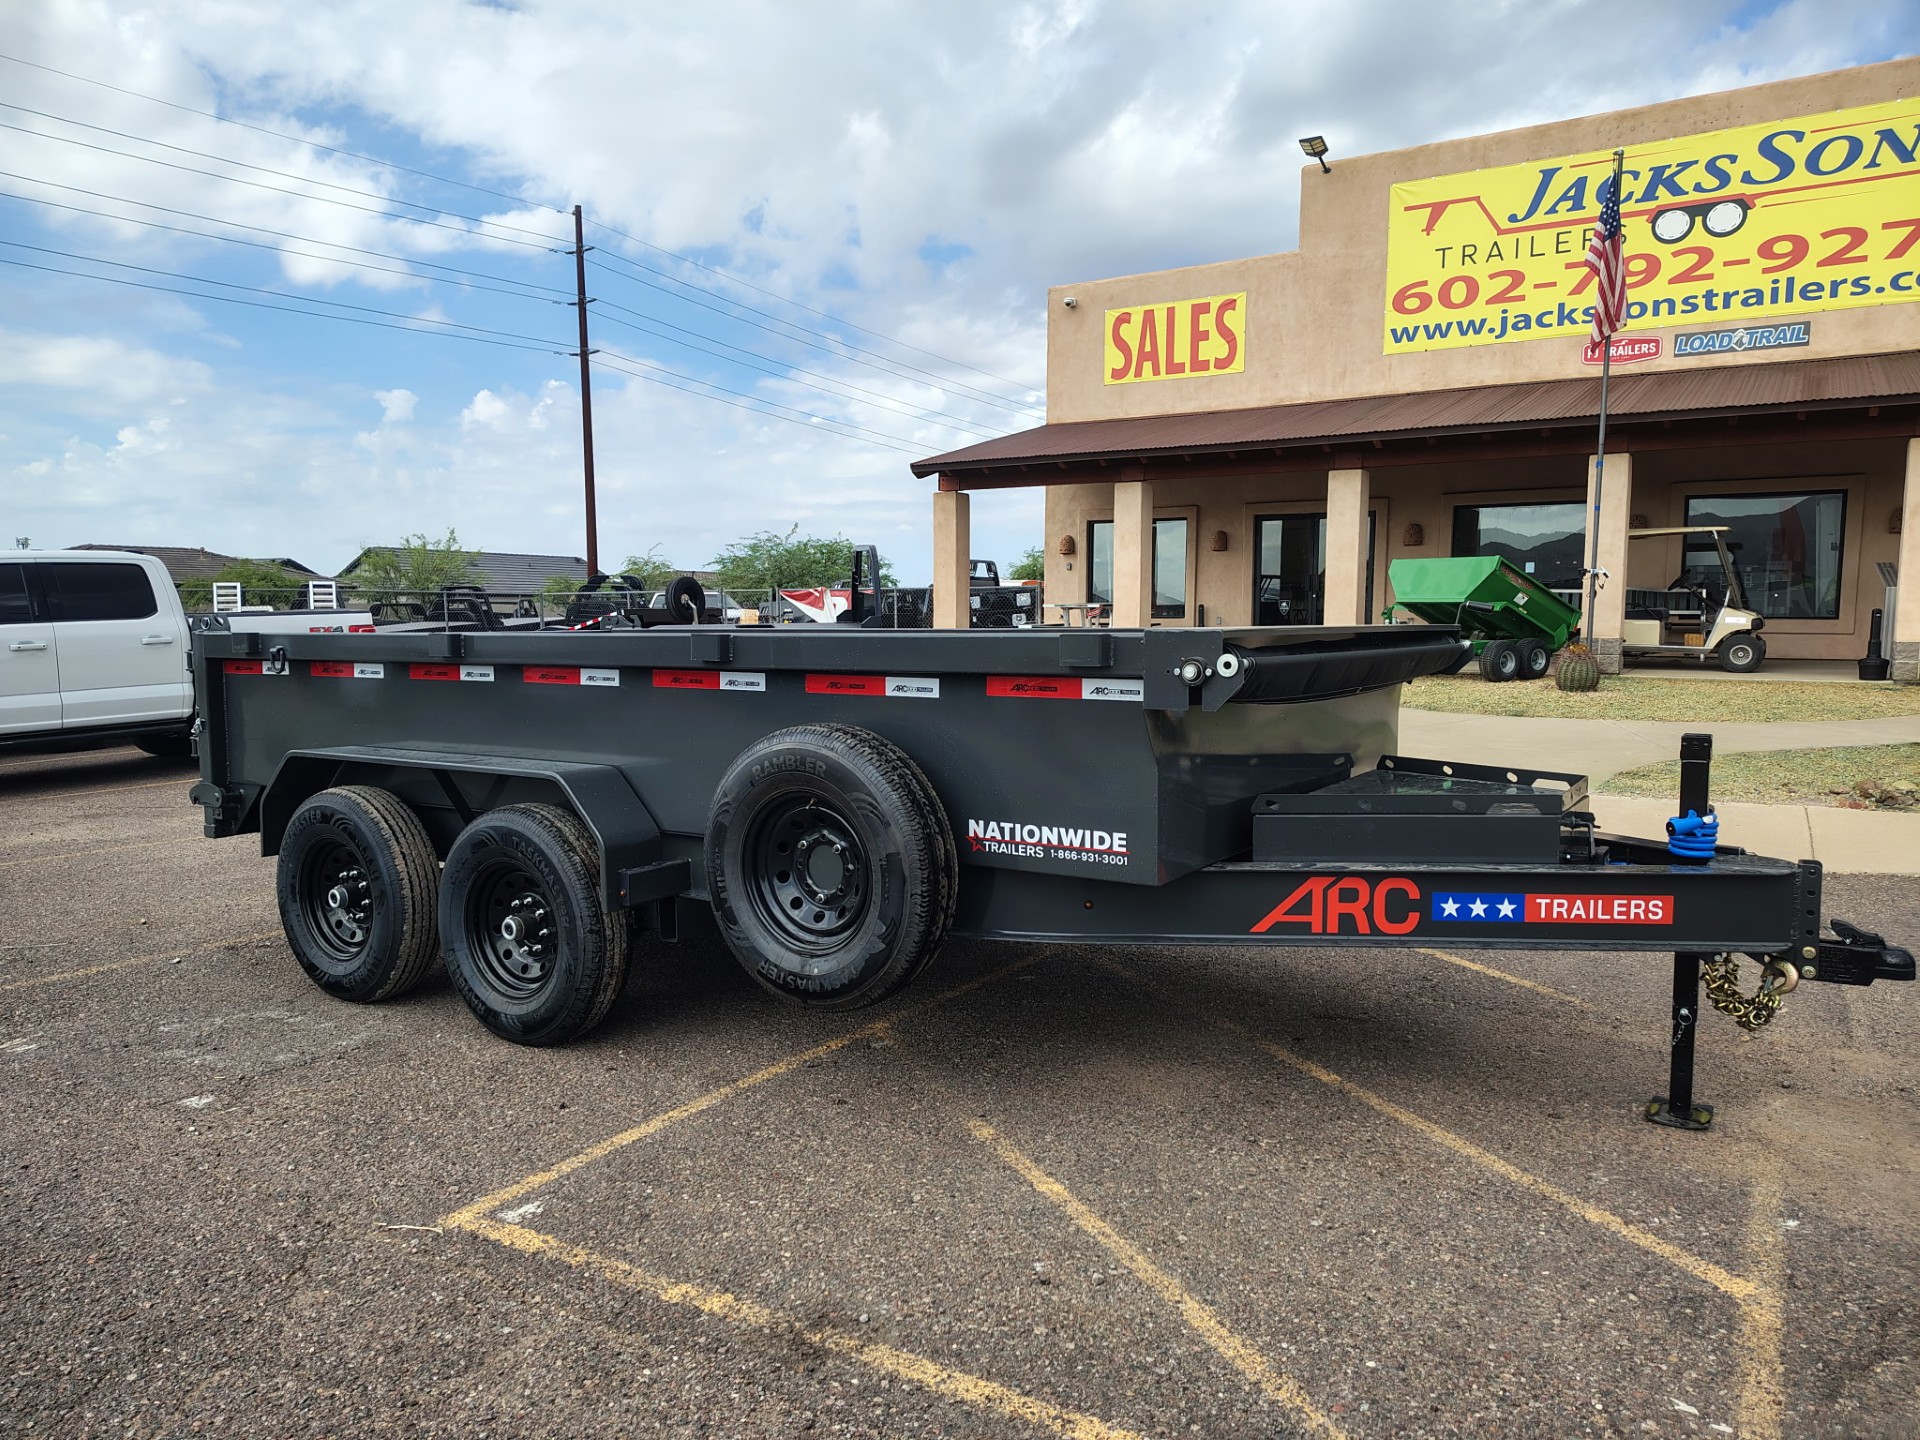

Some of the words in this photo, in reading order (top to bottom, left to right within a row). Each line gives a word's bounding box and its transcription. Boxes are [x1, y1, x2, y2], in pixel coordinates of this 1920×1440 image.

[1110, 298, 1238, 381] SALES
[1603, 343, 1656, 358] RAILERS
[1675, 331, 1733, 355] LOAD
[1745, 325, 1809, 347] TRAIL
[751, 754, 827, 780] RAMBLER
[968, 819, 1127, 852] NATIONWIDE
[983, 841, 1044, 858] TRAILERS
[1050, 849, 1128, 866] 1-866-931-3001
[511, 835, 571, 928] TASKMASTER
[1249, 876, 1421, 935] ARC
[1536, 898, 1663, 920] TRAILERS
